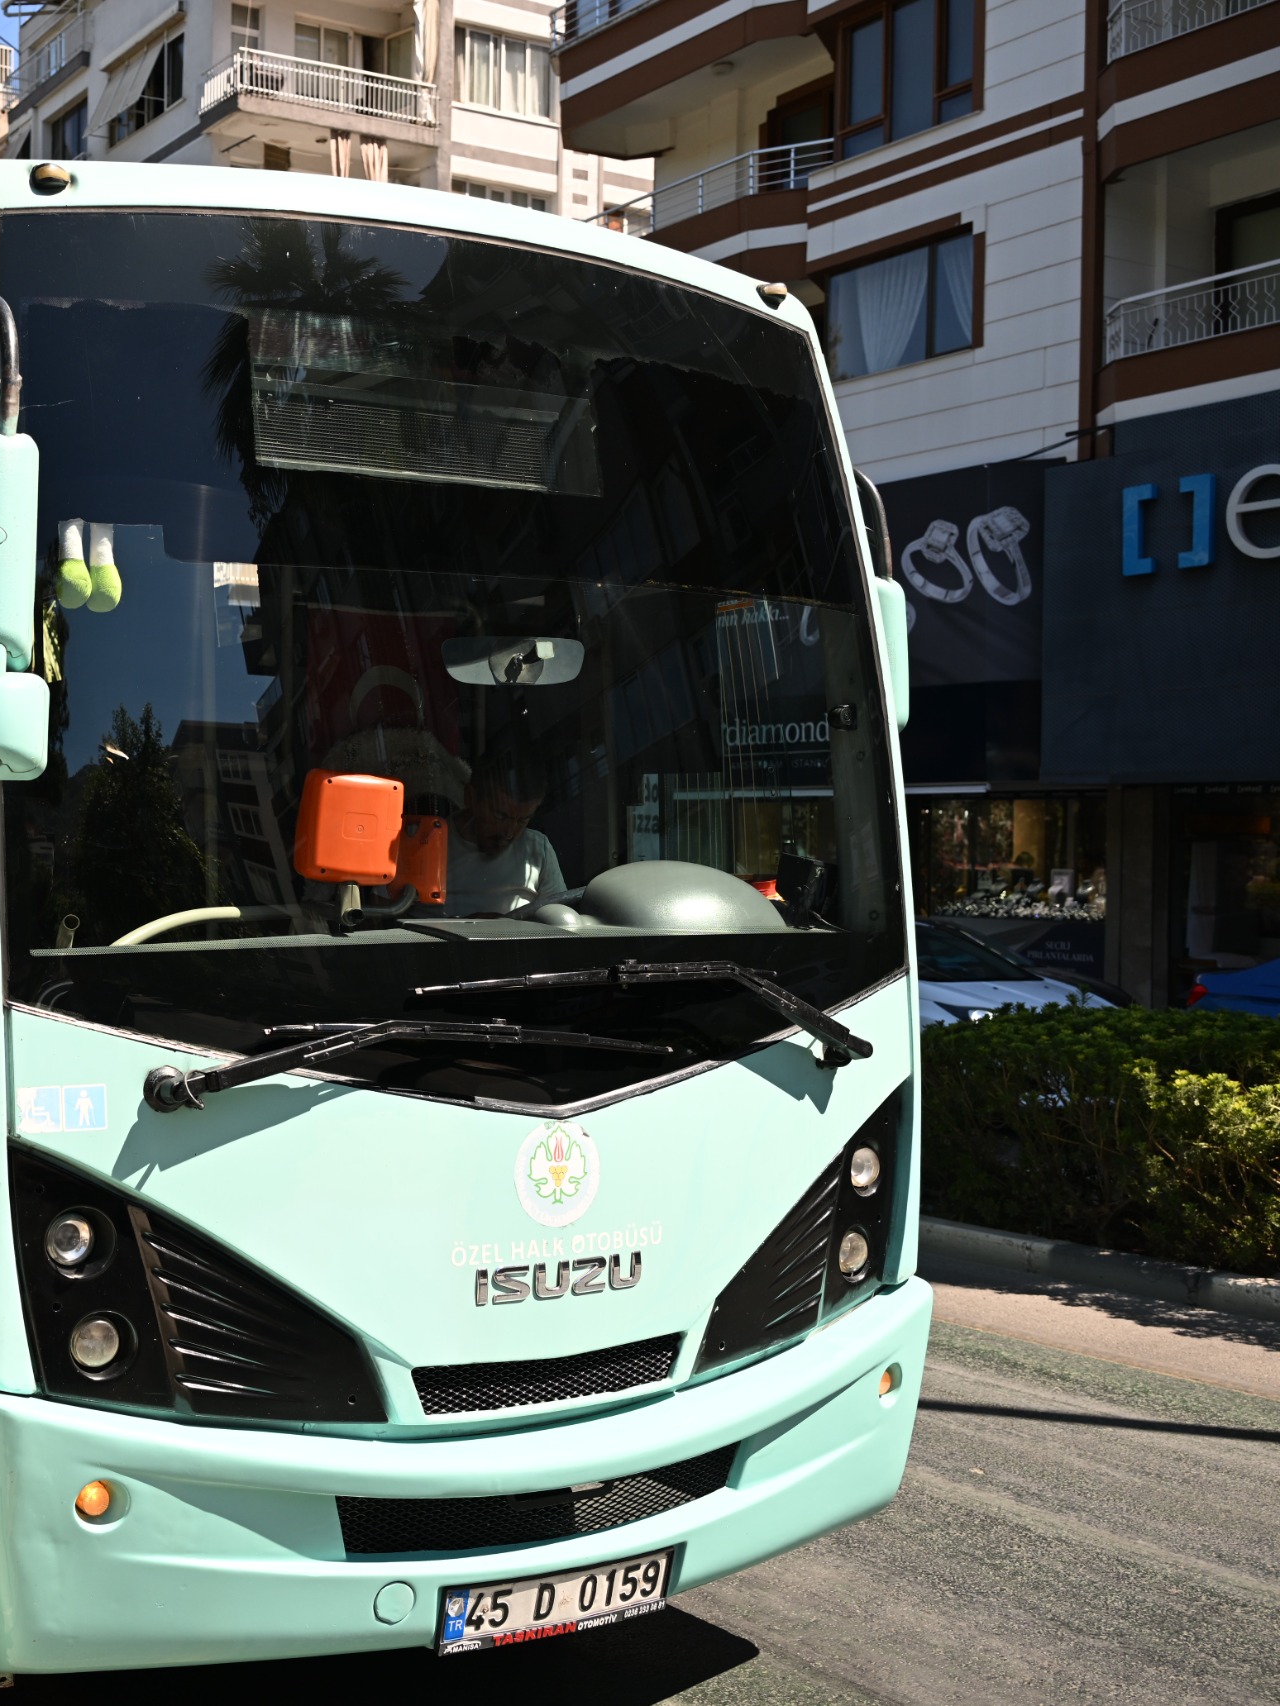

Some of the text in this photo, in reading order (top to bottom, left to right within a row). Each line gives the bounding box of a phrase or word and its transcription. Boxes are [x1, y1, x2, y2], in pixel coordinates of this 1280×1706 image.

[451, 1221, 663, 1267] ÖZEL HALK OTOBÜSÜ
[476, 1250, 642, 1307] ISUZU
[465, 1559, 662, 1632] 45 D 0159
[448, 1620, 463, 1632] TR
